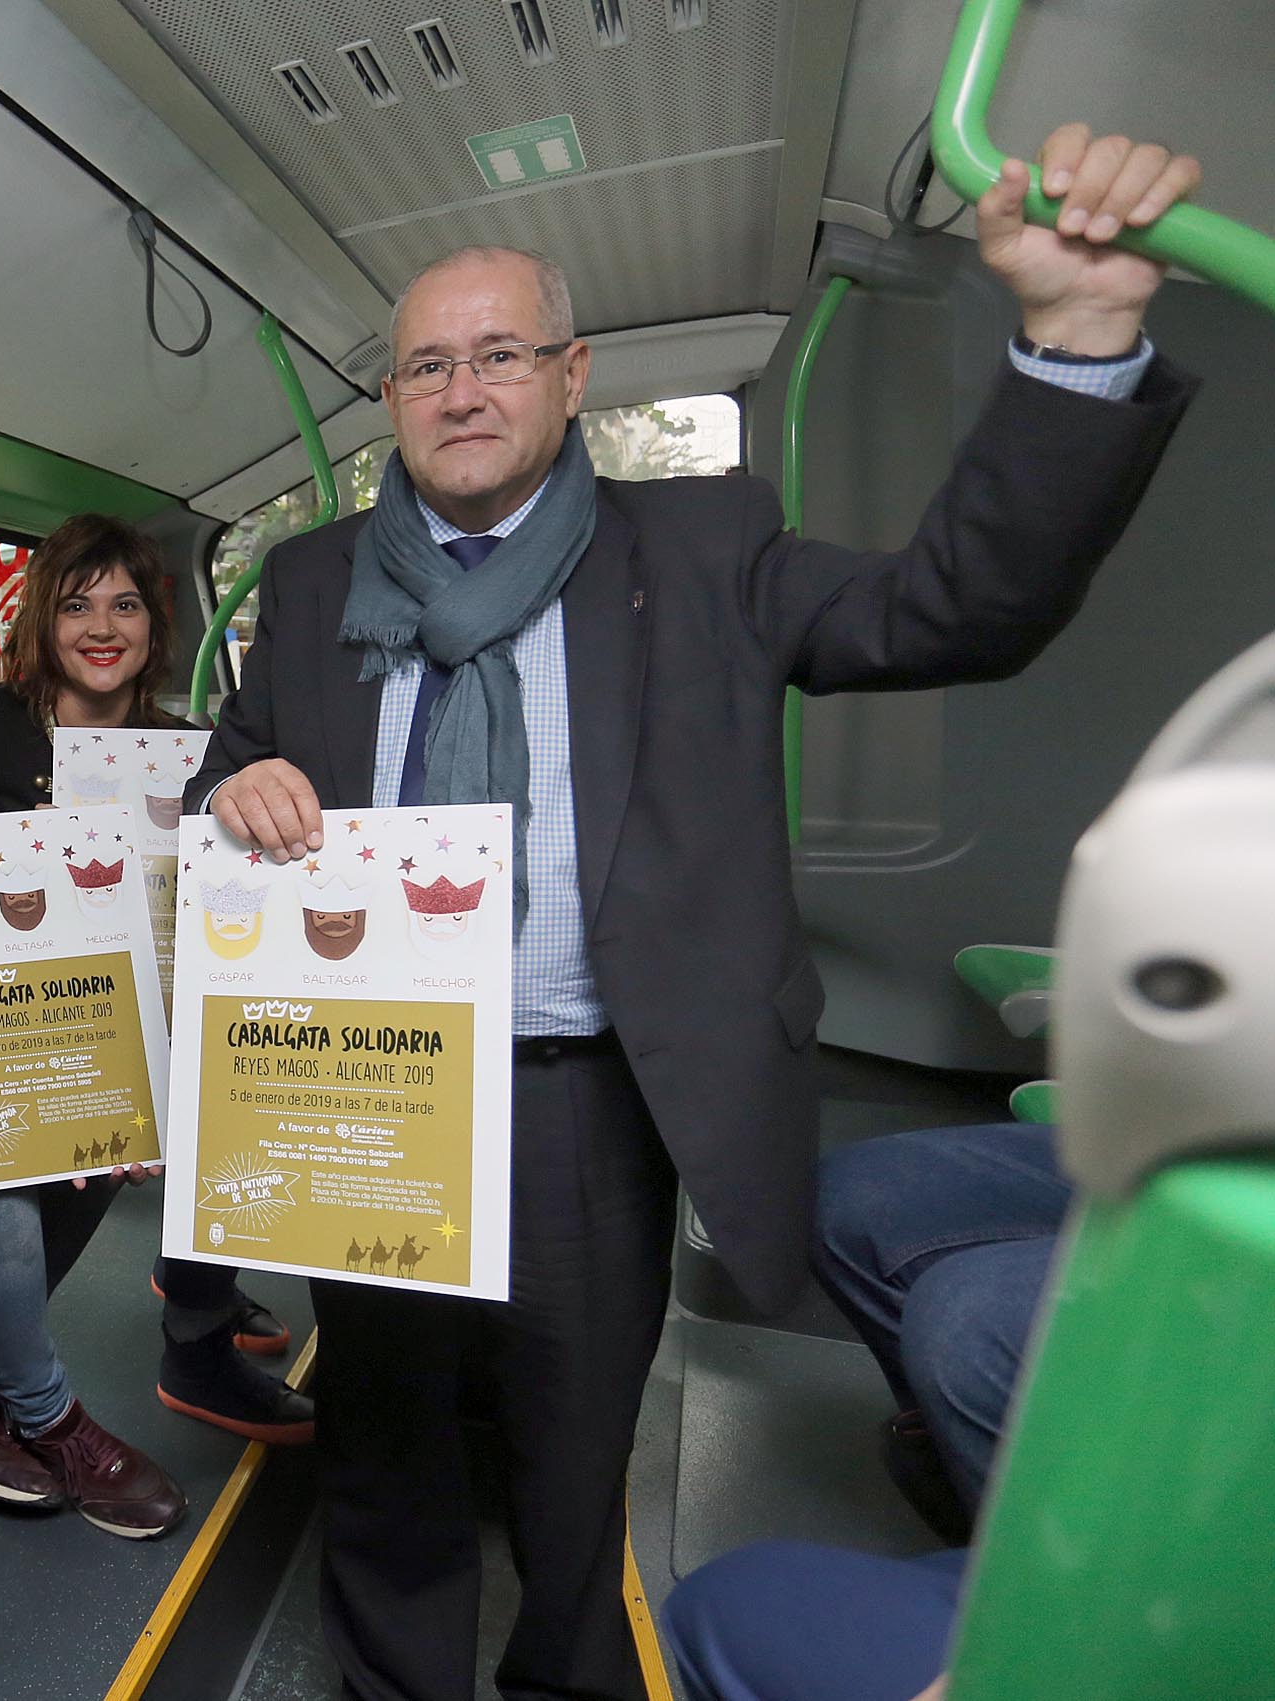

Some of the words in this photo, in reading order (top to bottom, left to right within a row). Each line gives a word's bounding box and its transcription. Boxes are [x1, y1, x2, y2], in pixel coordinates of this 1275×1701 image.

[146, 838, 180, 847] BALTAS
[4, 939, 55, 952] BALTASAR
[85, 932, 130, 944] MELCHOR
[208, 972, 254, 983] GASPAR
[302, 974, 368, 986] BALTASAR
[413, 977, 475, 988] MELCHOR
[41, 975, 115, 1002] SOLIDARIA
[42, 1005, 86, 1024] ALICANTE
[90, 1001, 113, 1019] 2019
[9, 1040, 20, 1051] de
[21, 1037, 43, 1050] 2019
[45, 1038, 51, 1047] a
[52, 1035, 65, 1046] las
[66, 1033, 72, 1044] 7
[74, 1032, 85, 1043] de
[86, 1031, 95, 1042] la
[95, 1029, 117, 1040] tarde
[227, 1022, 331, 1052] CABALGATA
[341, 1026, 443, 1057] SOLIDARIA
[5, 1065, 12, 1073] A
[13, 1063, 34, 1072] favor
[35, 1061, 45, 1069] de
[60, 1054, 92, 1063] Cáritas
[233, 1055, 270, 1076] REYES
[277, 1058, 319, 1079] MAGOS
[336, 1060, 395, 1083] ALICANTE
[404, 1065, 433, 1085] 2019
[230, 1089, 237, 1102] 5
[240, 1090, 252, 1102] de
[255, 1093, 285, 1105] enero
[287, 1093, 301, 1106] de
[304, 1093, 332, 1108] 2019
[334, 1098, 341, 1109] a
[345, 1096, 360, 1110] las
[364, 1097, 371, 1110] 7
[374, 1098, 388, 1112] de
[392, 1099, 402, 1113] la
[405, 1100, 434, 1115] tarde
[278, 1121, 286, 1131] A
[288, 1122, 315, 1133] favor
[316, 1125, 330, 1135] de
[350, 1124, 394, 1136] Cáritas
[259, 1140, 273, 1148] Fila
[273, 1141, 292, 1150] Cero
[309, 1144, 337, 1154] Cuenta
[341, 1147, 367, 1156] Banco
[368, 1149, 404, 1159] Sabadell
[348, 1157, 367, 1166] 0101
[214, 1182, 240, 1194] VENTA
[241, 1174, 284, 1191] ANTICIPADA
[311, 1170, 327, 1178] Este
[328, 1172, 341, 1180] año
[342, 1174, 368, 1183] puedes
[231, 1191, 242, 1203] DE
[247, 1187, 271, 1201] SILLAS
[311, 1178, 321, 1186] las
[322, 1180, 339, 1188] sillas
[350, 1182, 371, 1191] forma
[372, 1185, 408, 1195] anticipada
[311, 1187, 329, 1195] Plaza
[341, 1189, 360, 1199] Toros
[371, 1193, 400, 1202] Alicante
[413, 1197, 434, 1206] 10:00
[316, 1196, 337, 1205] 20:00
[371, 1201, 383, 1209] del
[406, 1205, 443, 1216] diciembre.
